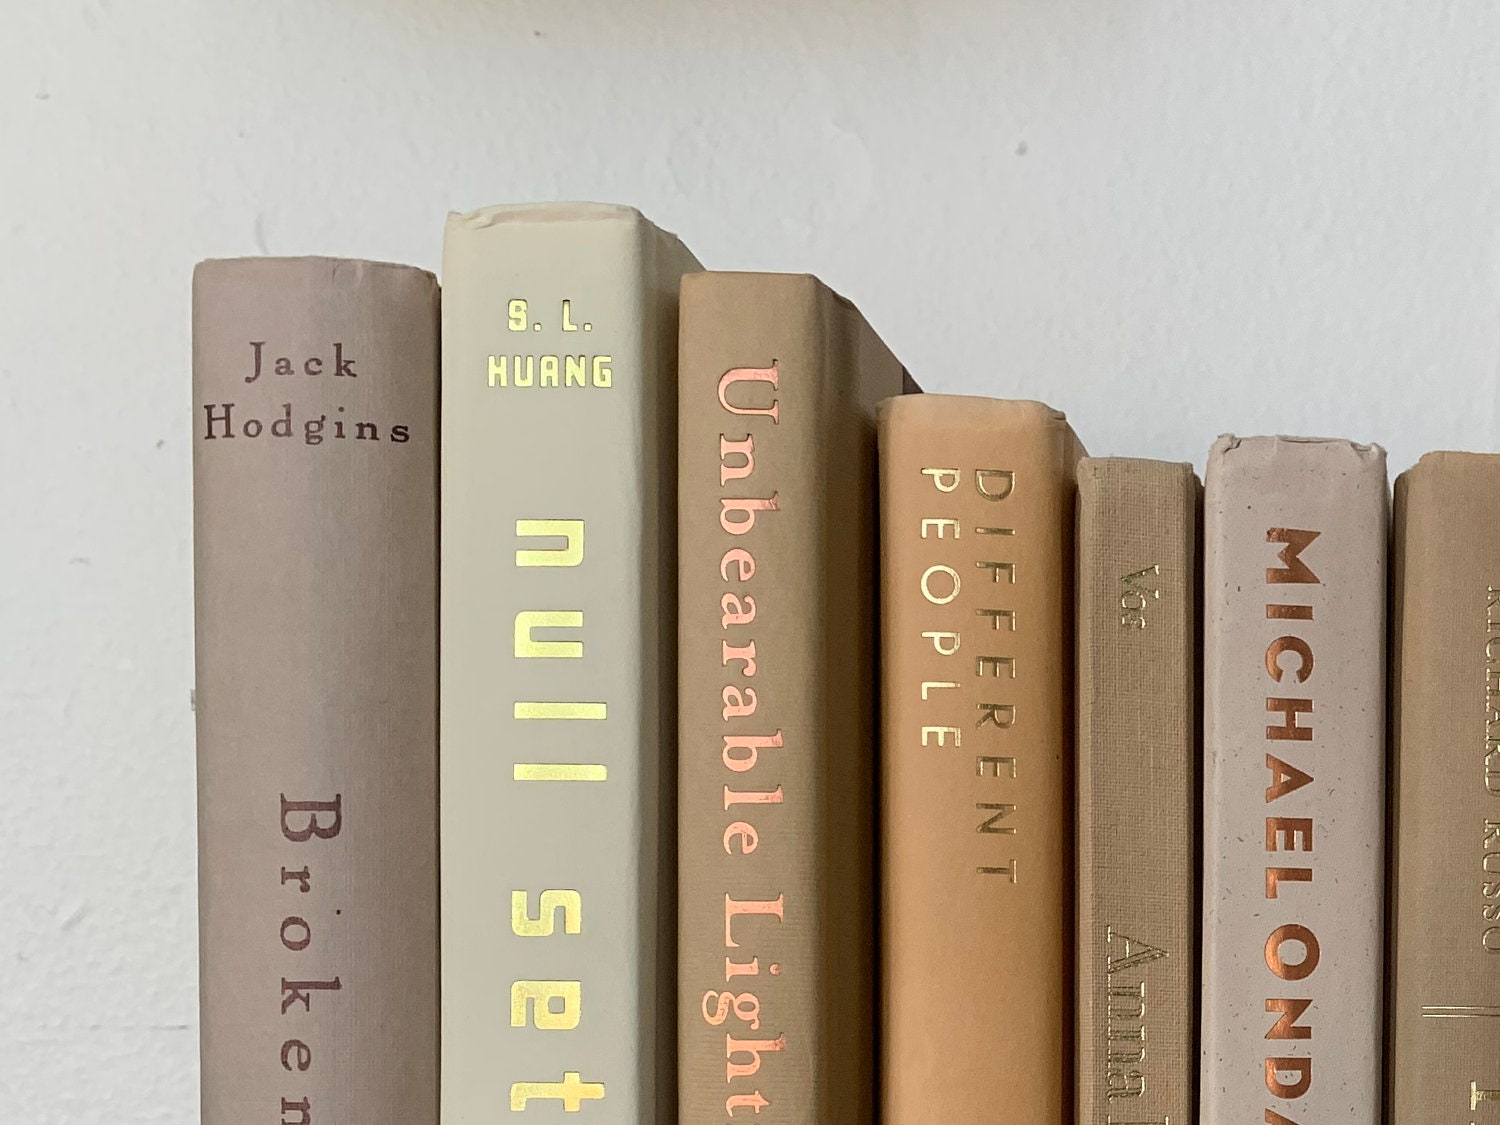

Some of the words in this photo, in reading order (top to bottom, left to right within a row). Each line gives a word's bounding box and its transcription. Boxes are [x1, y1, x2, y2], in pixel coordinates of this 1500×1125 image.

[203, 402, 411, 445] Hodgins
[245, 341, 359, 383] Jack
[487, 354, 614, 390] HUANG
[513, 518, 608, 782] null
[716, 357, 785, 858] Unbearable
[921, 468, 961, 748] PEOPLE
[975, 468, 1018, 884] DIFFERENT
[1265, 527, 1322, 899] MICHAEL
[509, 888, 607, 1113] set
[1106, 926, 1169, 1102] Anna
